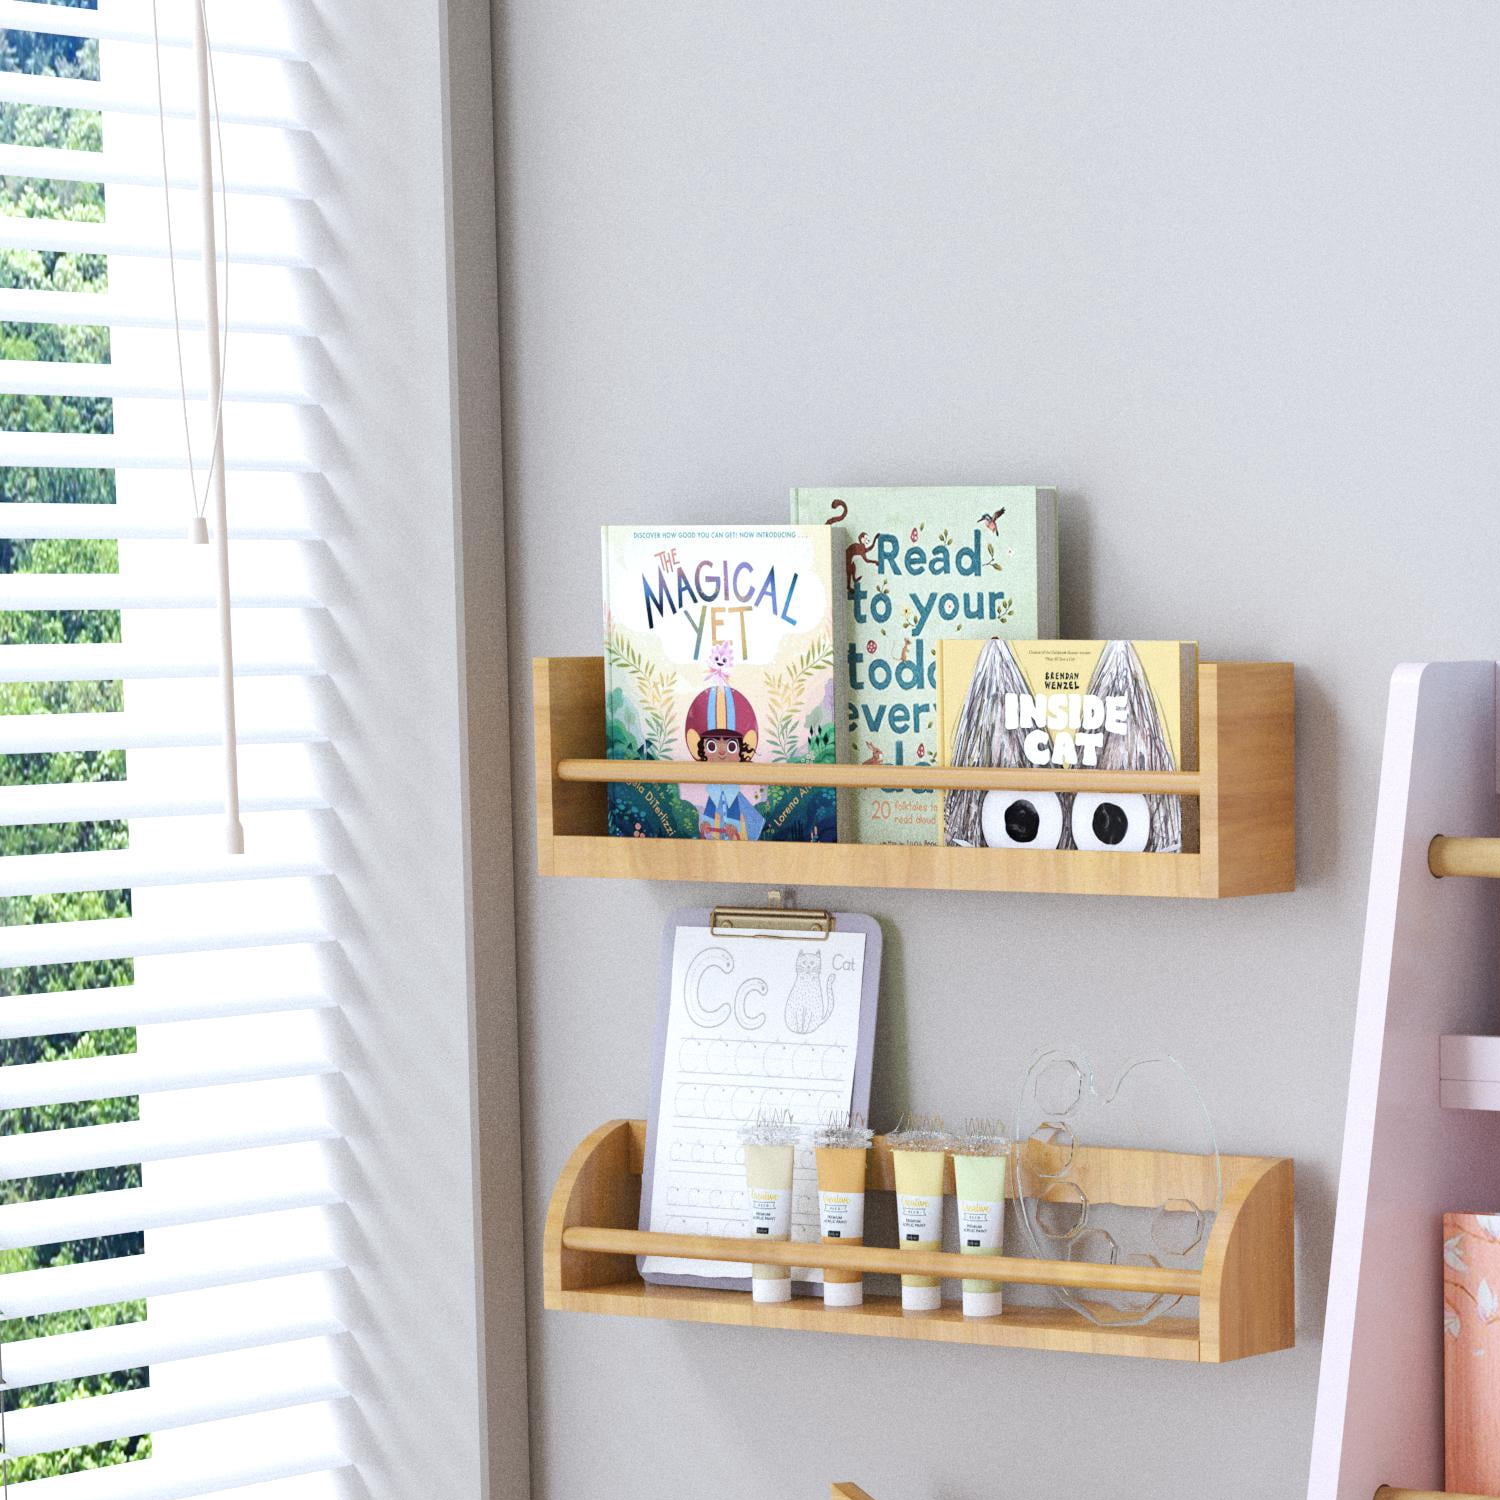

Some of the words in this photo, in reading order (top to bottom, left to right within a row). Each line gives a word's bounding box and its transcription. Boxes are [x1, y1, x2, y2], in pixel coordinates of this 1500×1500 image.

[654, 548, 680, 573] THE
[877, 529, 982, 577] Read
[641, 560, 799, 629] MAGICAL
[847, 582, 892, 624] to
[910, 592, 1005, 637] your
[683, 605, 753, 661] YET
[1045, 672, 1080, 680] BRENDAN
[1045, 681, 1080, 690] WENZEL
[848, 702, 937, 734] ever
[1005, 691, 1129, 736] INSIDE
[1024, 729, 1104, 766] CAT
[872, 800, 891, 820] 20
[832, 953, 856, 972] Cat
